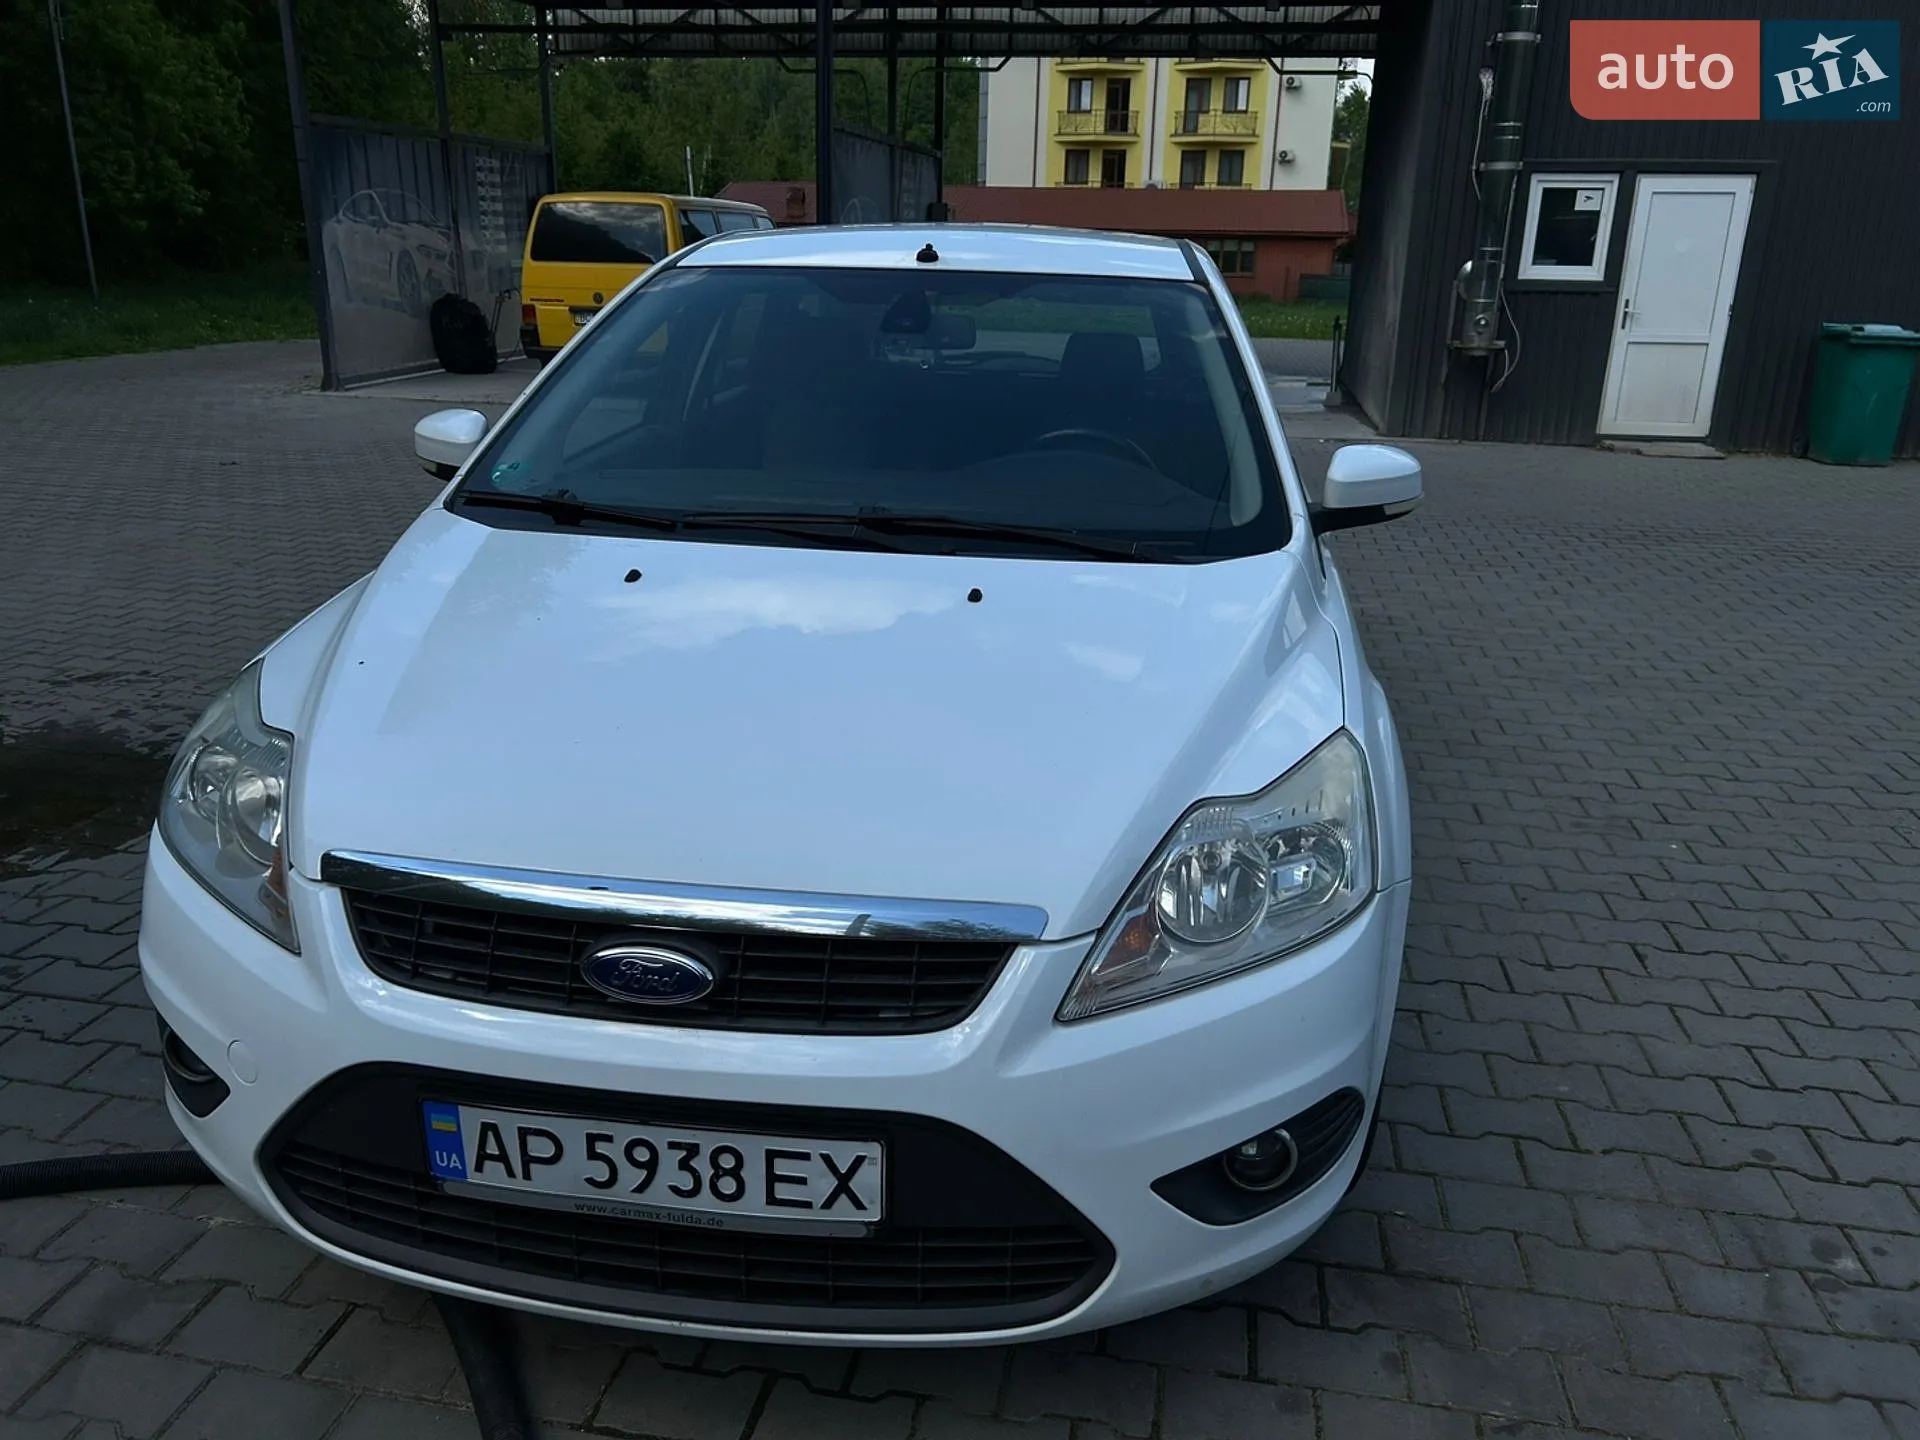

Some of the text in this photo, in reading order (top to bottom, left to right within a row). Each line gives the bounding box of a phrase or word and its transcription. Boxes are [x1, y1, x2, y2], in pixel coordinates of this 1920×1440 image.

[610, 959, 680, 991] Ford
[435, 1150, 462, 1169] UA
[474, 1121, 868, 1211] AP 5938 EX
[574, 1202, 723, 1227] www.carmax-fulda.de
